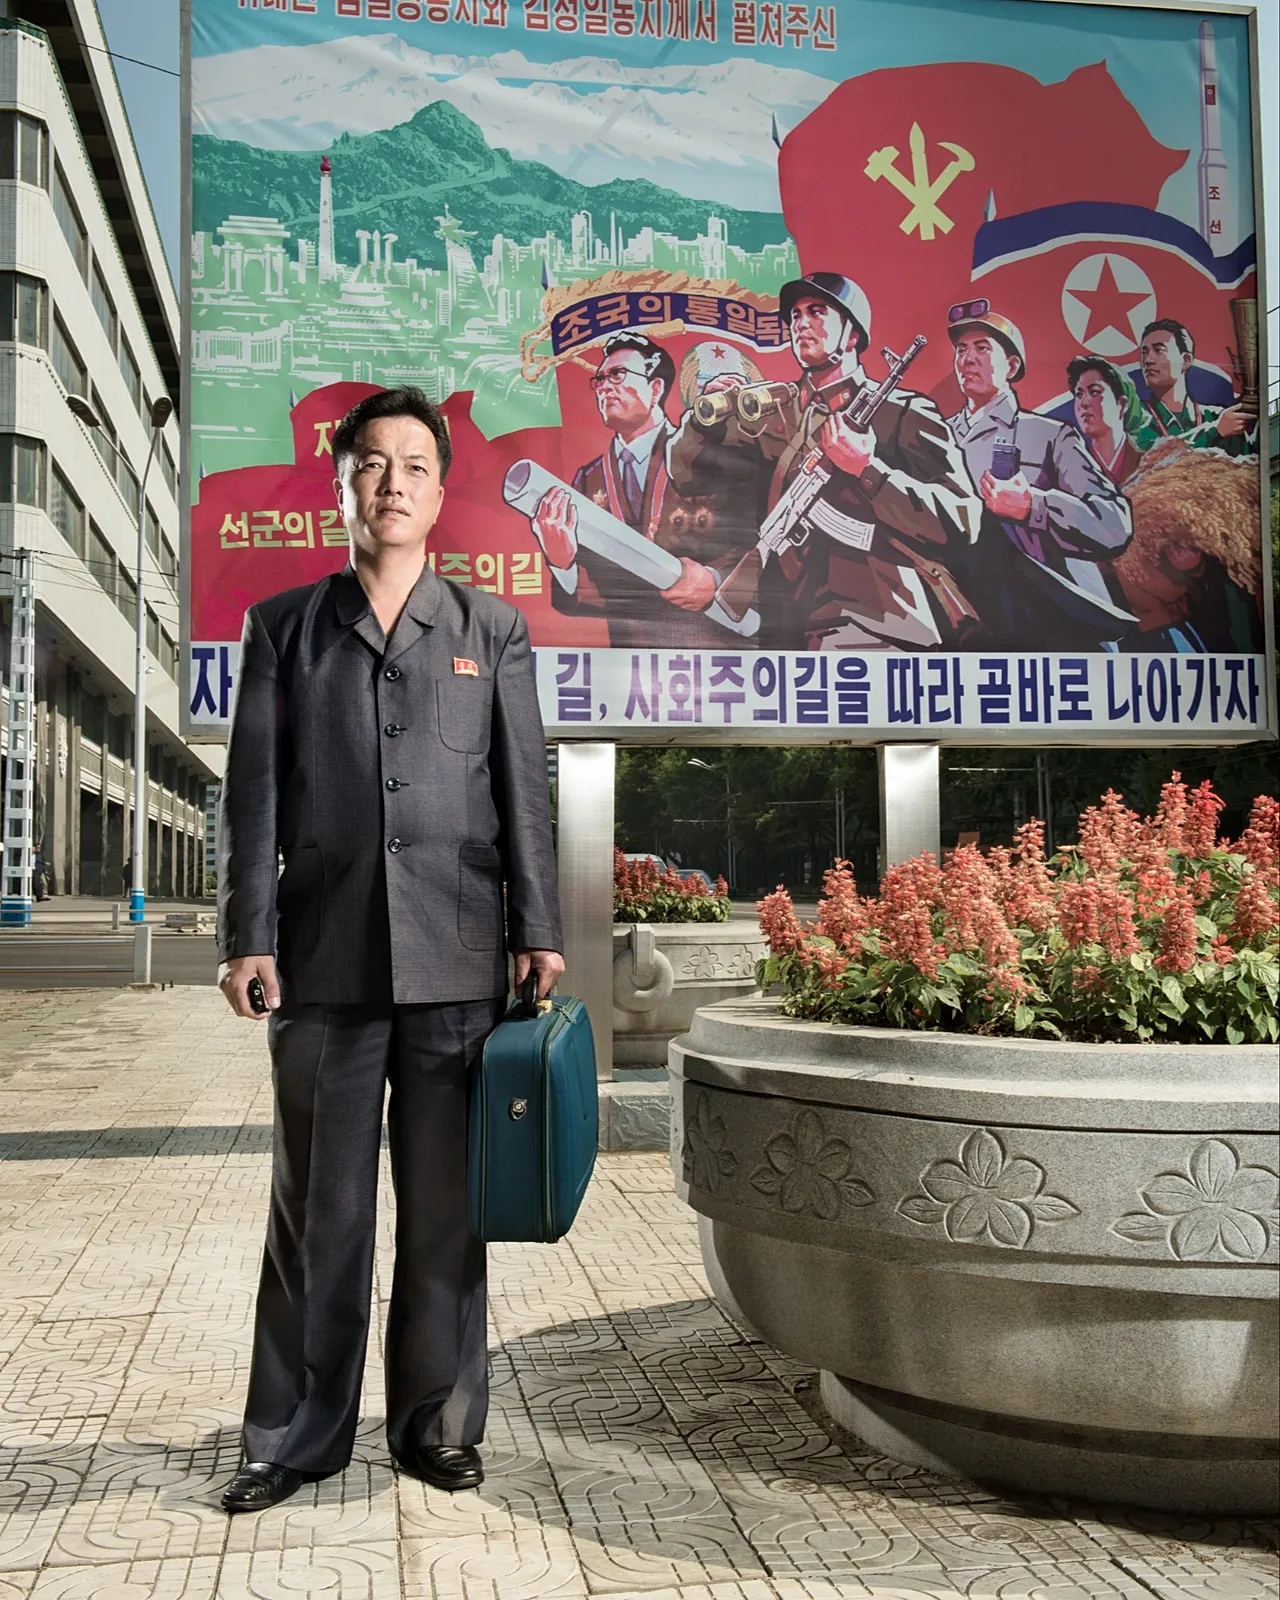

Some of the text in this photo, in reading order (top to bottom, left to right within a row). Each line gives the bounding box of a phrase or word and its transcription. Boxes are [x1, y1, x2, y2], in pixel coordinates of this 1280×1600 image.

[734, 2, 836, 49] 펼쳐주신
[558, 295, 671, 350] 조국의
[624, 653, 870, 724] 사회주의길을
[887, 657, 964, 724] 따라
[977, 657, 1092, 724] 곧바로
[1106, 657, 1259, 724] 나아가자
